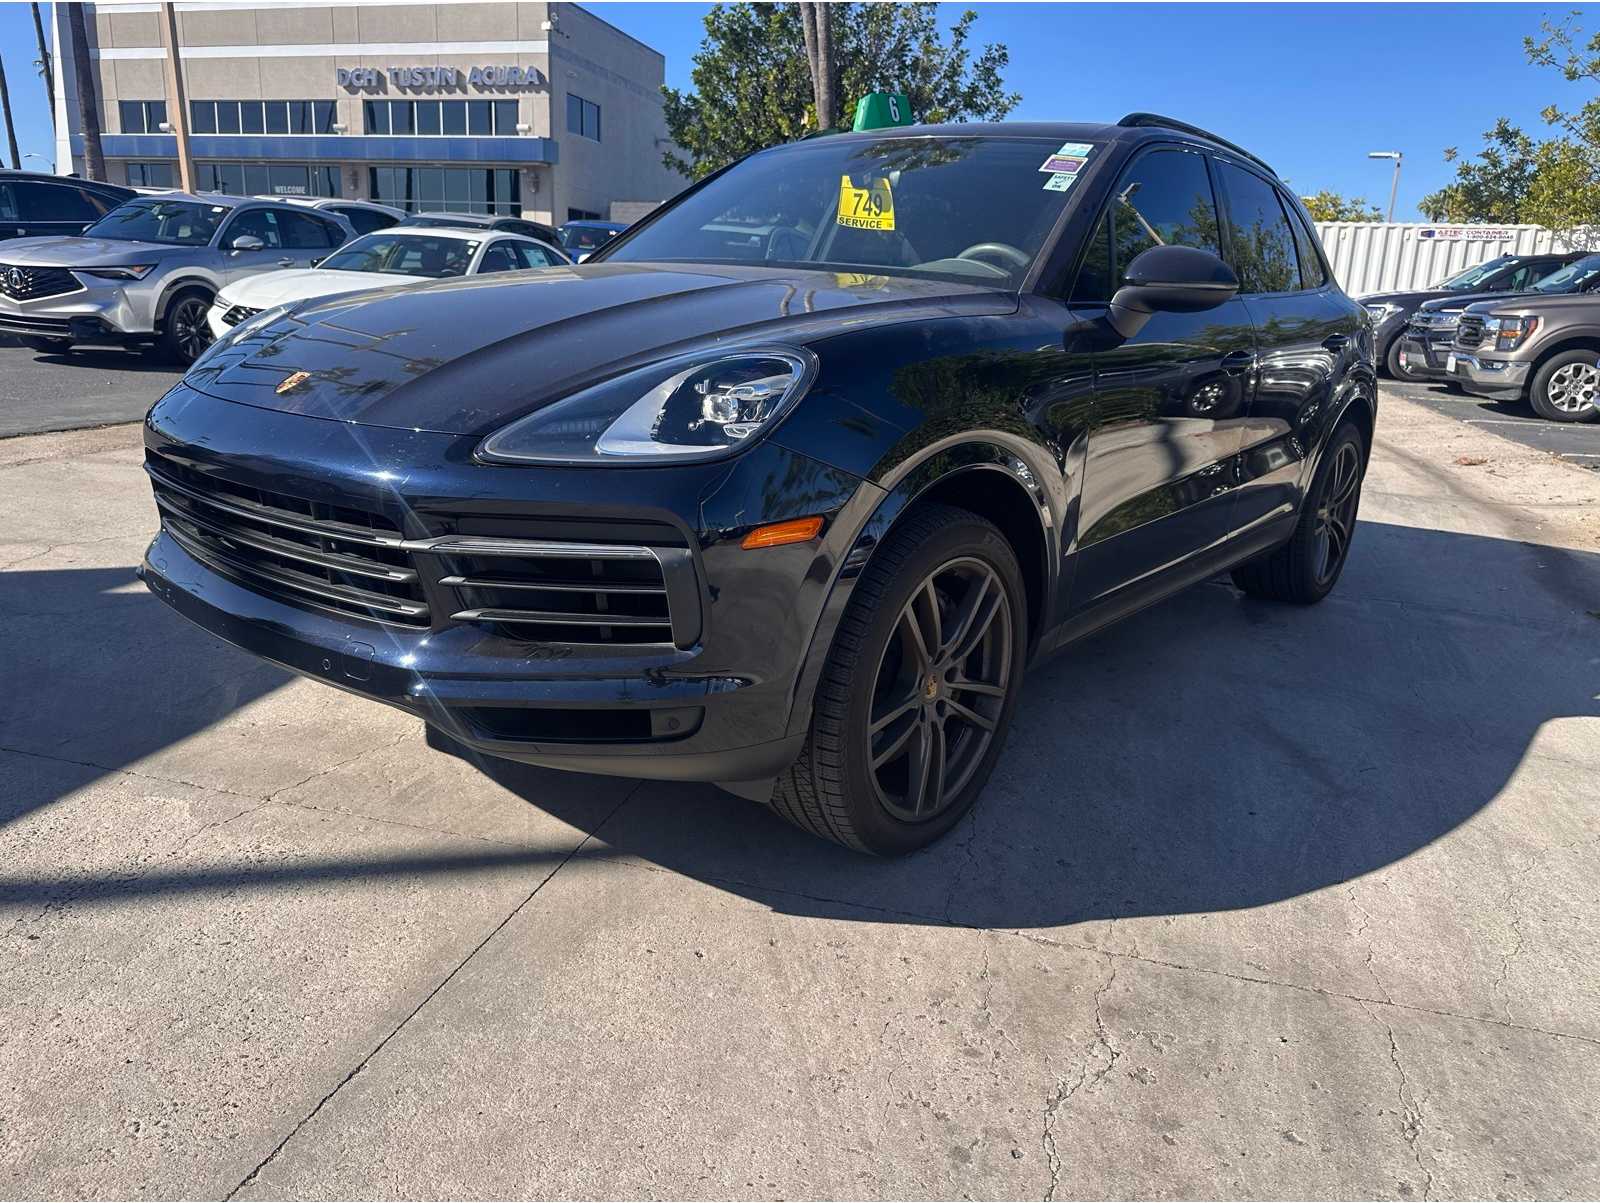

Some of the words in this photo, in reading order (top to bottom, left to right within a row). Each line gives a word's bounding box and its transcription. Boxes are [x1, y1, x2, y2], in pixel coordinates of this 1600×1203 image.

[336, 67, 377, 87] DCH
[387, 66, 457, 87] TUSTIN
[468, 65, 539, 86] ACURA
[888, 96, 900, 122] 6
[274, 185, 306, 194] WELCOME
[853, 192, 883, 217] 749
[838, 216, 882, 229] SERVICE
